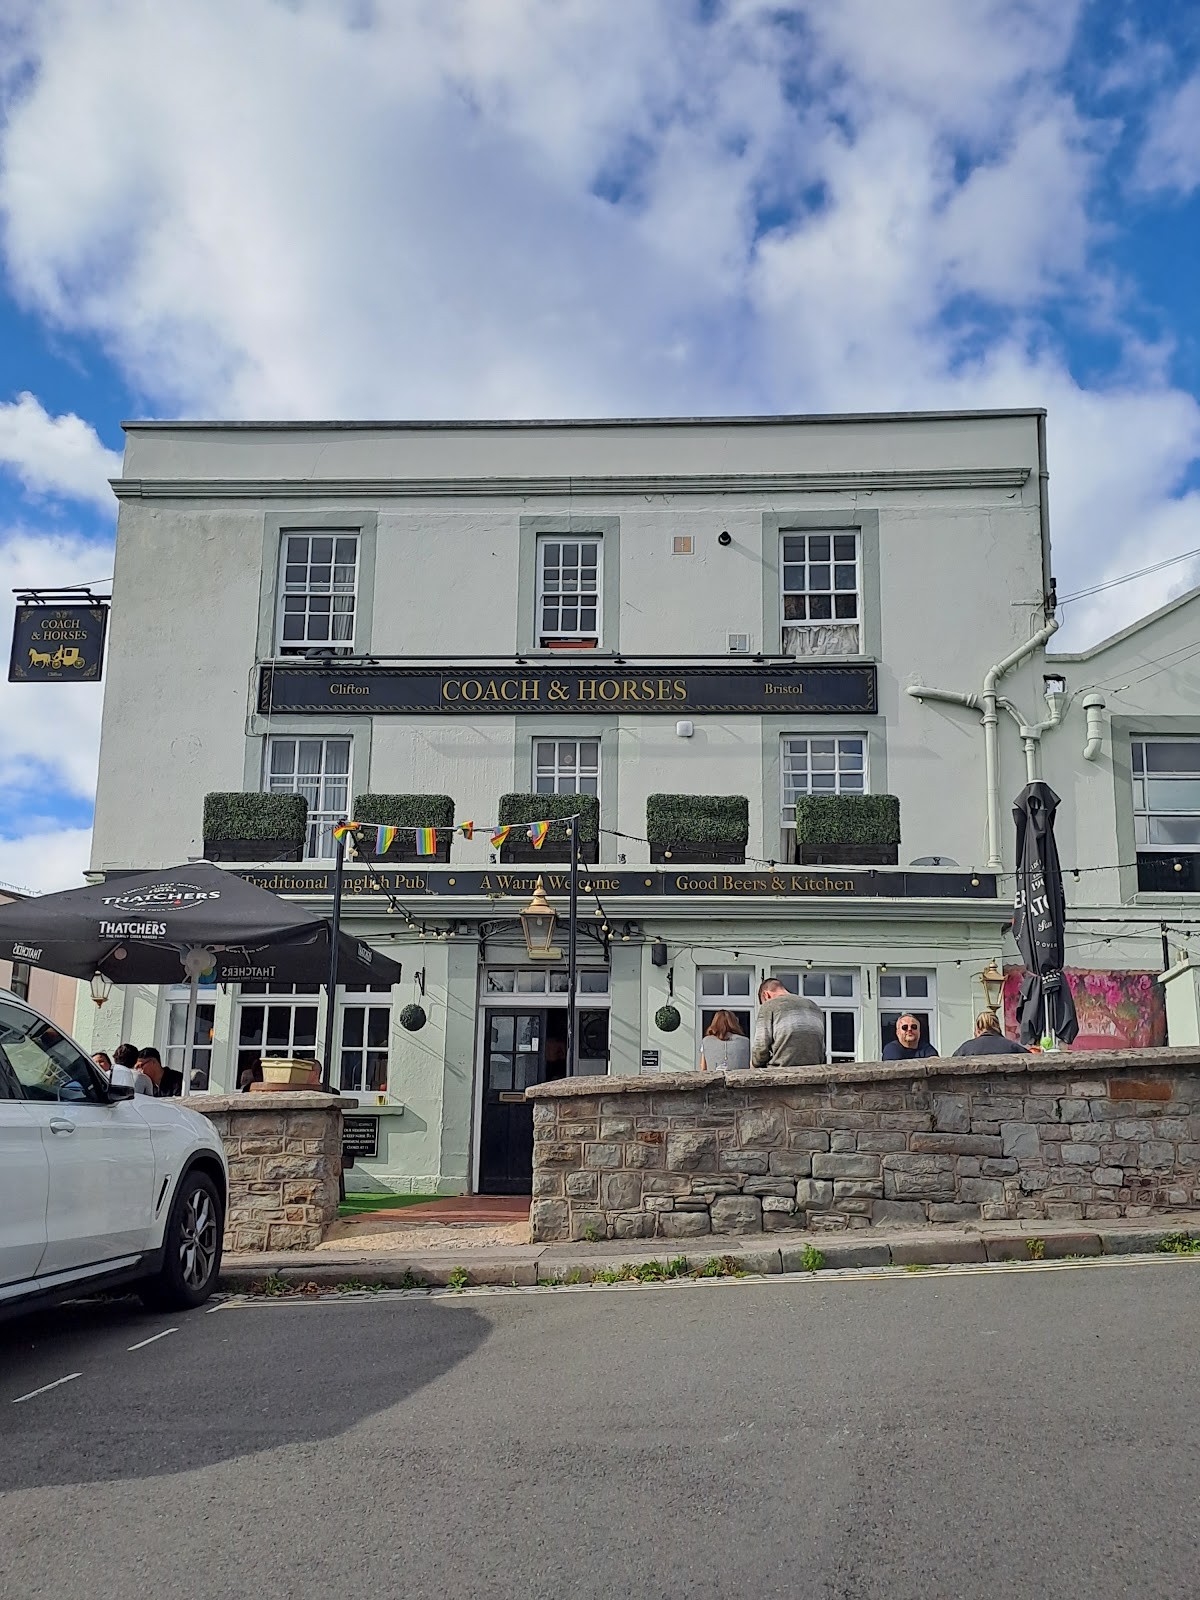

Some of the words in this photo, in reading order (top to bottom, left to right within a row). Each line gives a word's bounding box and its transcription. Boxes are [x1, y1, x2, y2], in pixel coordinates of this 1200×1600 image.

[41, 619, 80, 629] COACH
[31, 631, 40, 640] &
[43, 630, 88, 640] HORSES
[329, 683, 370, 695] Clifton
[442, 679, 541, 701] COACH
[547, 680, 570, 701] &
[577, 679, 687, 701] HORSES
[764, 682, 803, 695] Bristol
[240, 874, 329, 890] Traditional
[333, 874, 390, 893] nglih
[394, 874, 425, 890] Pub
[480, 875, 492, 890] A
[547, 874, 620, 891] Wecome
[676, 875, 718, 891] Good
[722, 875, 767, 891] Beers
[771, 875, 786, 891] &
[790, 875, 855, 892] Kitchen
[101, 890, 221, 905] THATCHERS
[99, 921, 167, 935] THATCHERS
